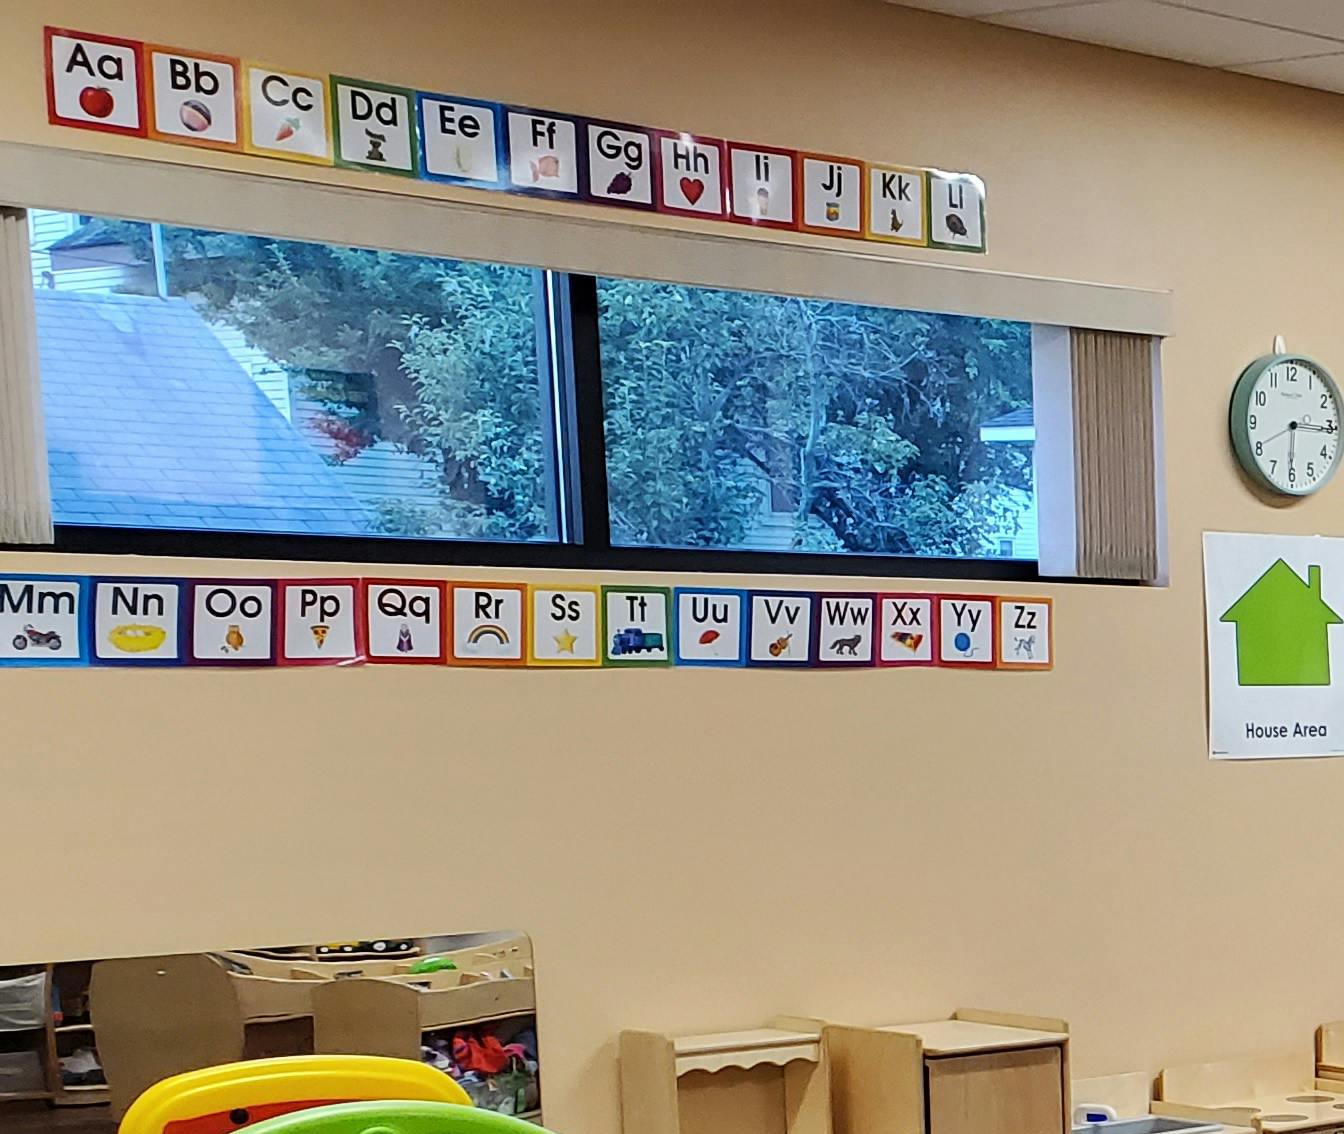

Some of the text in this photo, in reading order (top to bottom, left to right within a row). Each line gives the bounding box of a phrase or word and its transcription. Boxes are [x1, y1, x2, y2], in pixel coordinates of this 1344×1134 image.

[66, 43, 964, 210] Aa Bb Cc Dd Ee Ff Gg Hh Ii Jj Kk Ll
[1269, 372, 1278, 388] 11
[1286, 367, 1298, 382] 12
[1308, 375, 1312, 390] 1
[1255, 391, 1267, 407] 10
[1320, 394, 1328, 409] 2
[1249, 415, 1257, 430] 9
[1325, 420, 1334, 434] 3
[1255, 441, 1263, 456] 8
[1320, 445, 1328, 459] 4
[1269, 460, 1278, 475] 7
[1288, 467, 1296, 483] 6
[1306, 462, 1315, 477] 5
[0, 584, 1038, 633] Mm Nn Oo Pp Qq Rr Ss Tt Uu Vv Ww Xx Yy Zz
[1246, 722, 1327, 739] House Area
